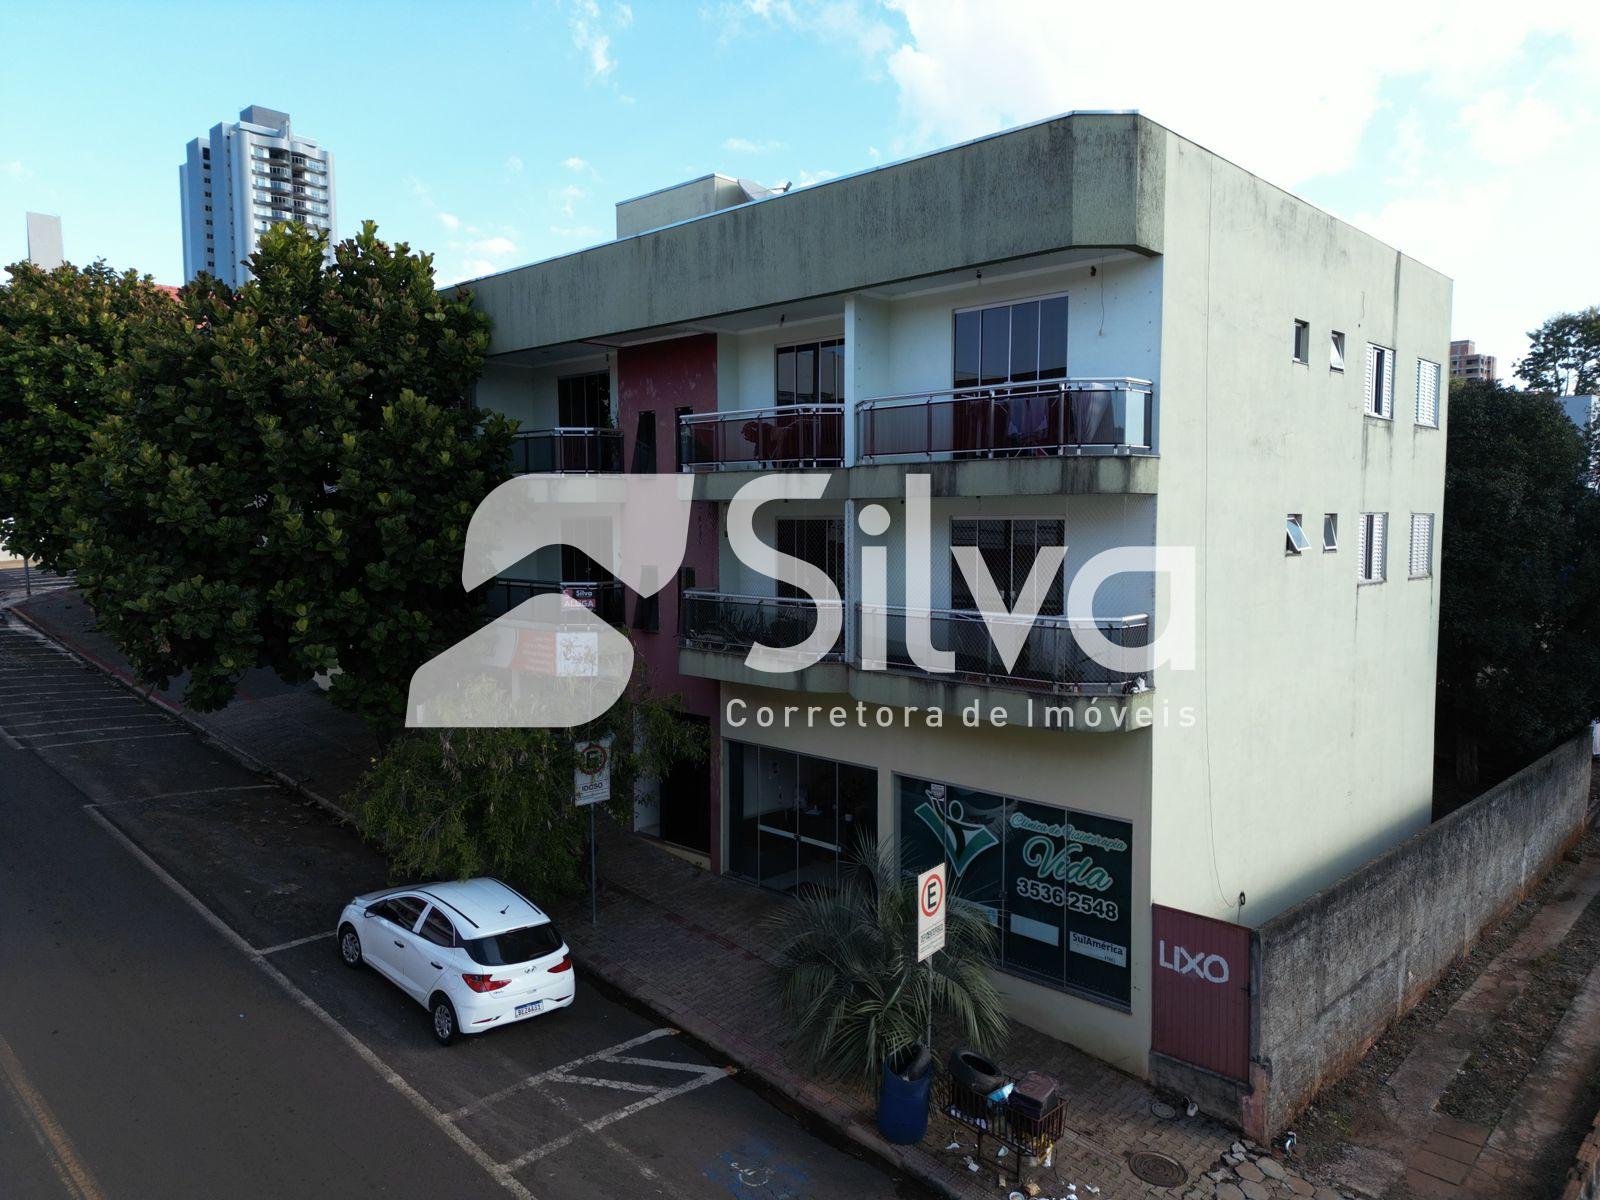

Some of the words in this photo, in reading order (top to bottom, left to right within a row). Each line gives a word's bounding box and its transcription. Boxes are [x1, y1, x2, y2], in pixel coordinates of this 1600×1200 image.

[575, 589, 593, 597] Silva
[1023, 835, 1113, 891] Vida
[927, 881, 937, 910] E
[1072, 933, 1123, 956] SulAmérica
[1159, 940, 1229, 983] LIXO
